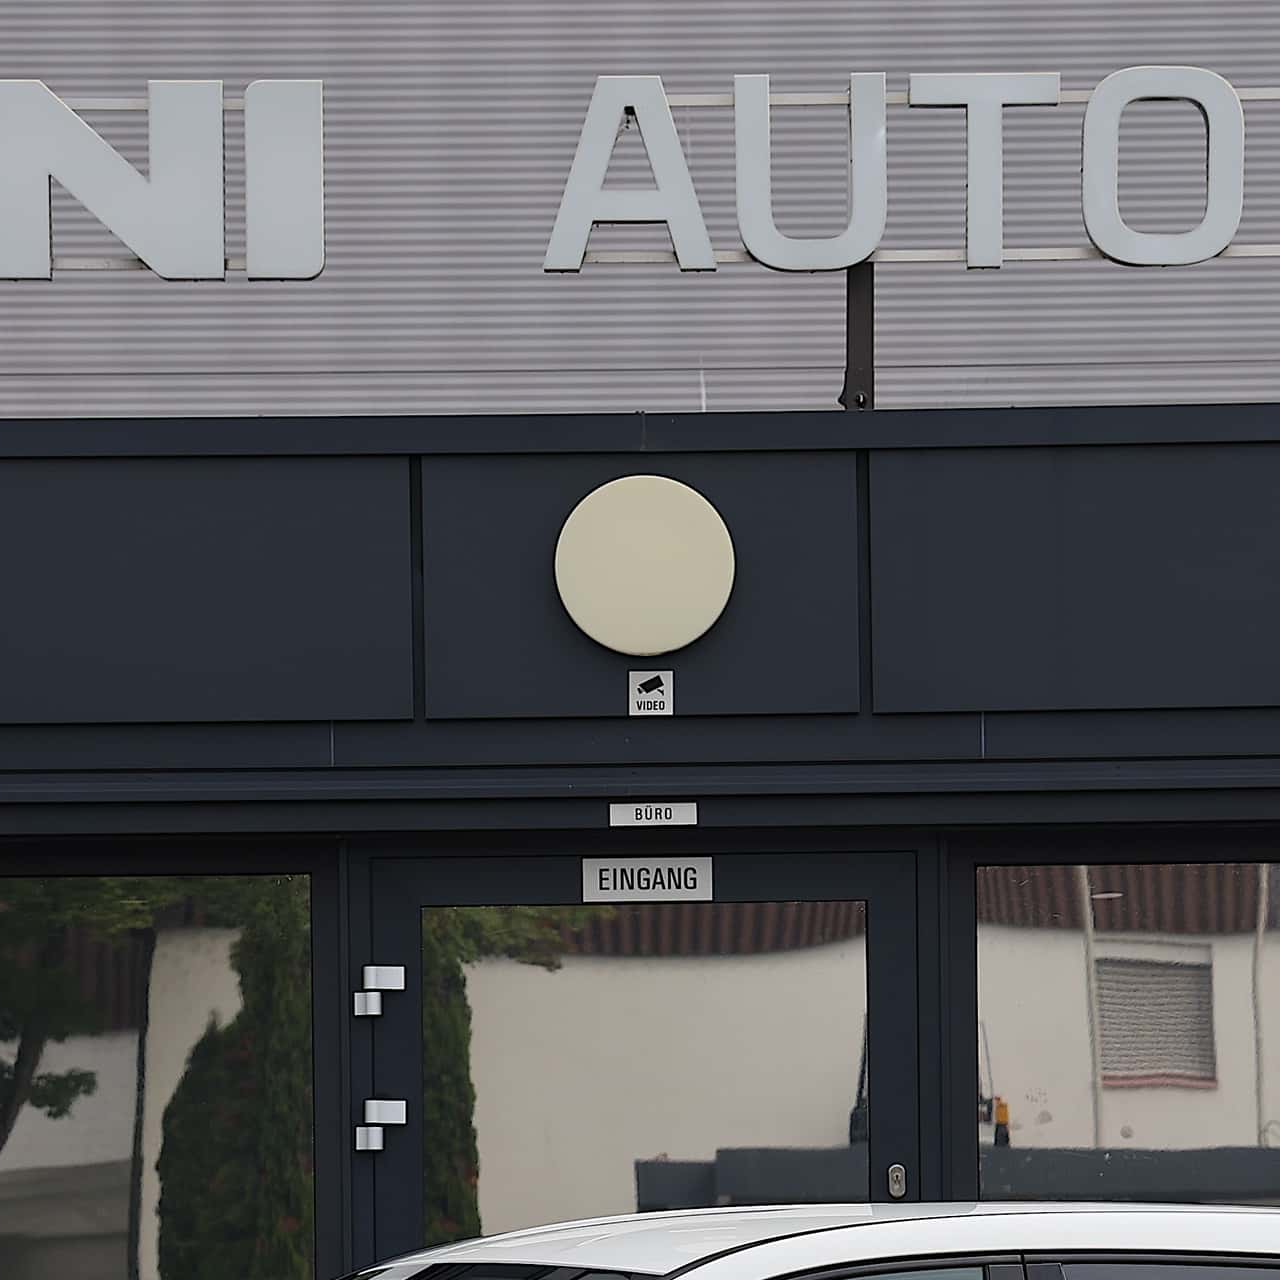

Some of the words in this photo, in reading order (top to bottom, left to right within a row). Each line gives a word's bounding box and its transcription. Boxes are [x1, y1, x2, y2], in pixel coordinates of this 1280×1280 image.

[543, 64, 1246, 274] AUTO
[636, 700, 665, 711] VIDEO
[635, 805, 673, 821] BÜRO
[599, 867, 698, 891] EINGANG
